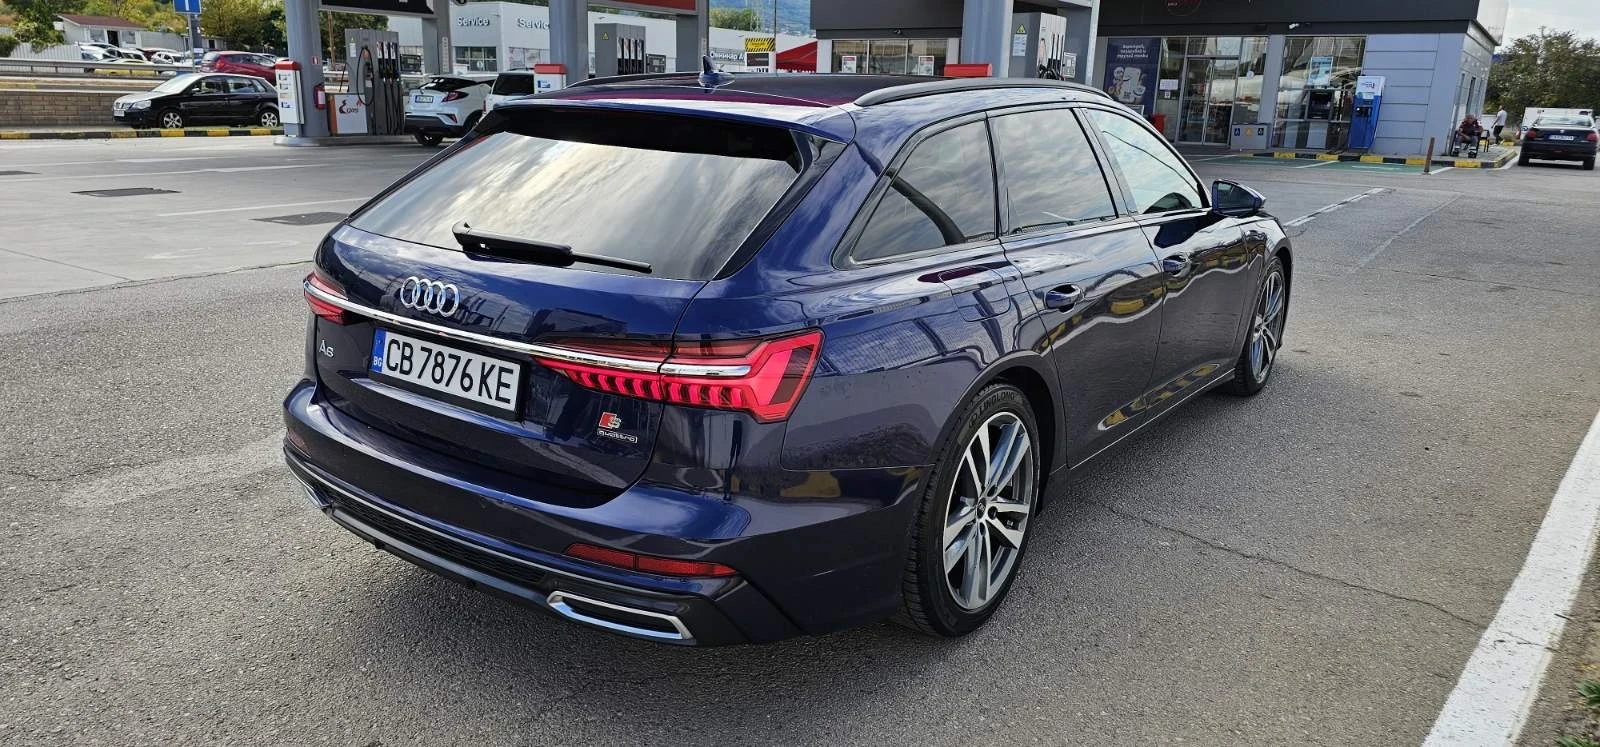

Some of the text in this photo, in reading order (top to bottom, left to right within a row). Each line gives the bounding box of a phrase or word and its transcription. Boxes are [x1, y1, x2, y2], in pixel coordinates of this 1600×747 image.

[457, 16, 489, 26] Service
[519, 18, 549, 30] Servic
[319, 339, 334, 358] A6
[373, 355, 383, 367] BG
[386, 338, 514, 404] CB 7876 KE
